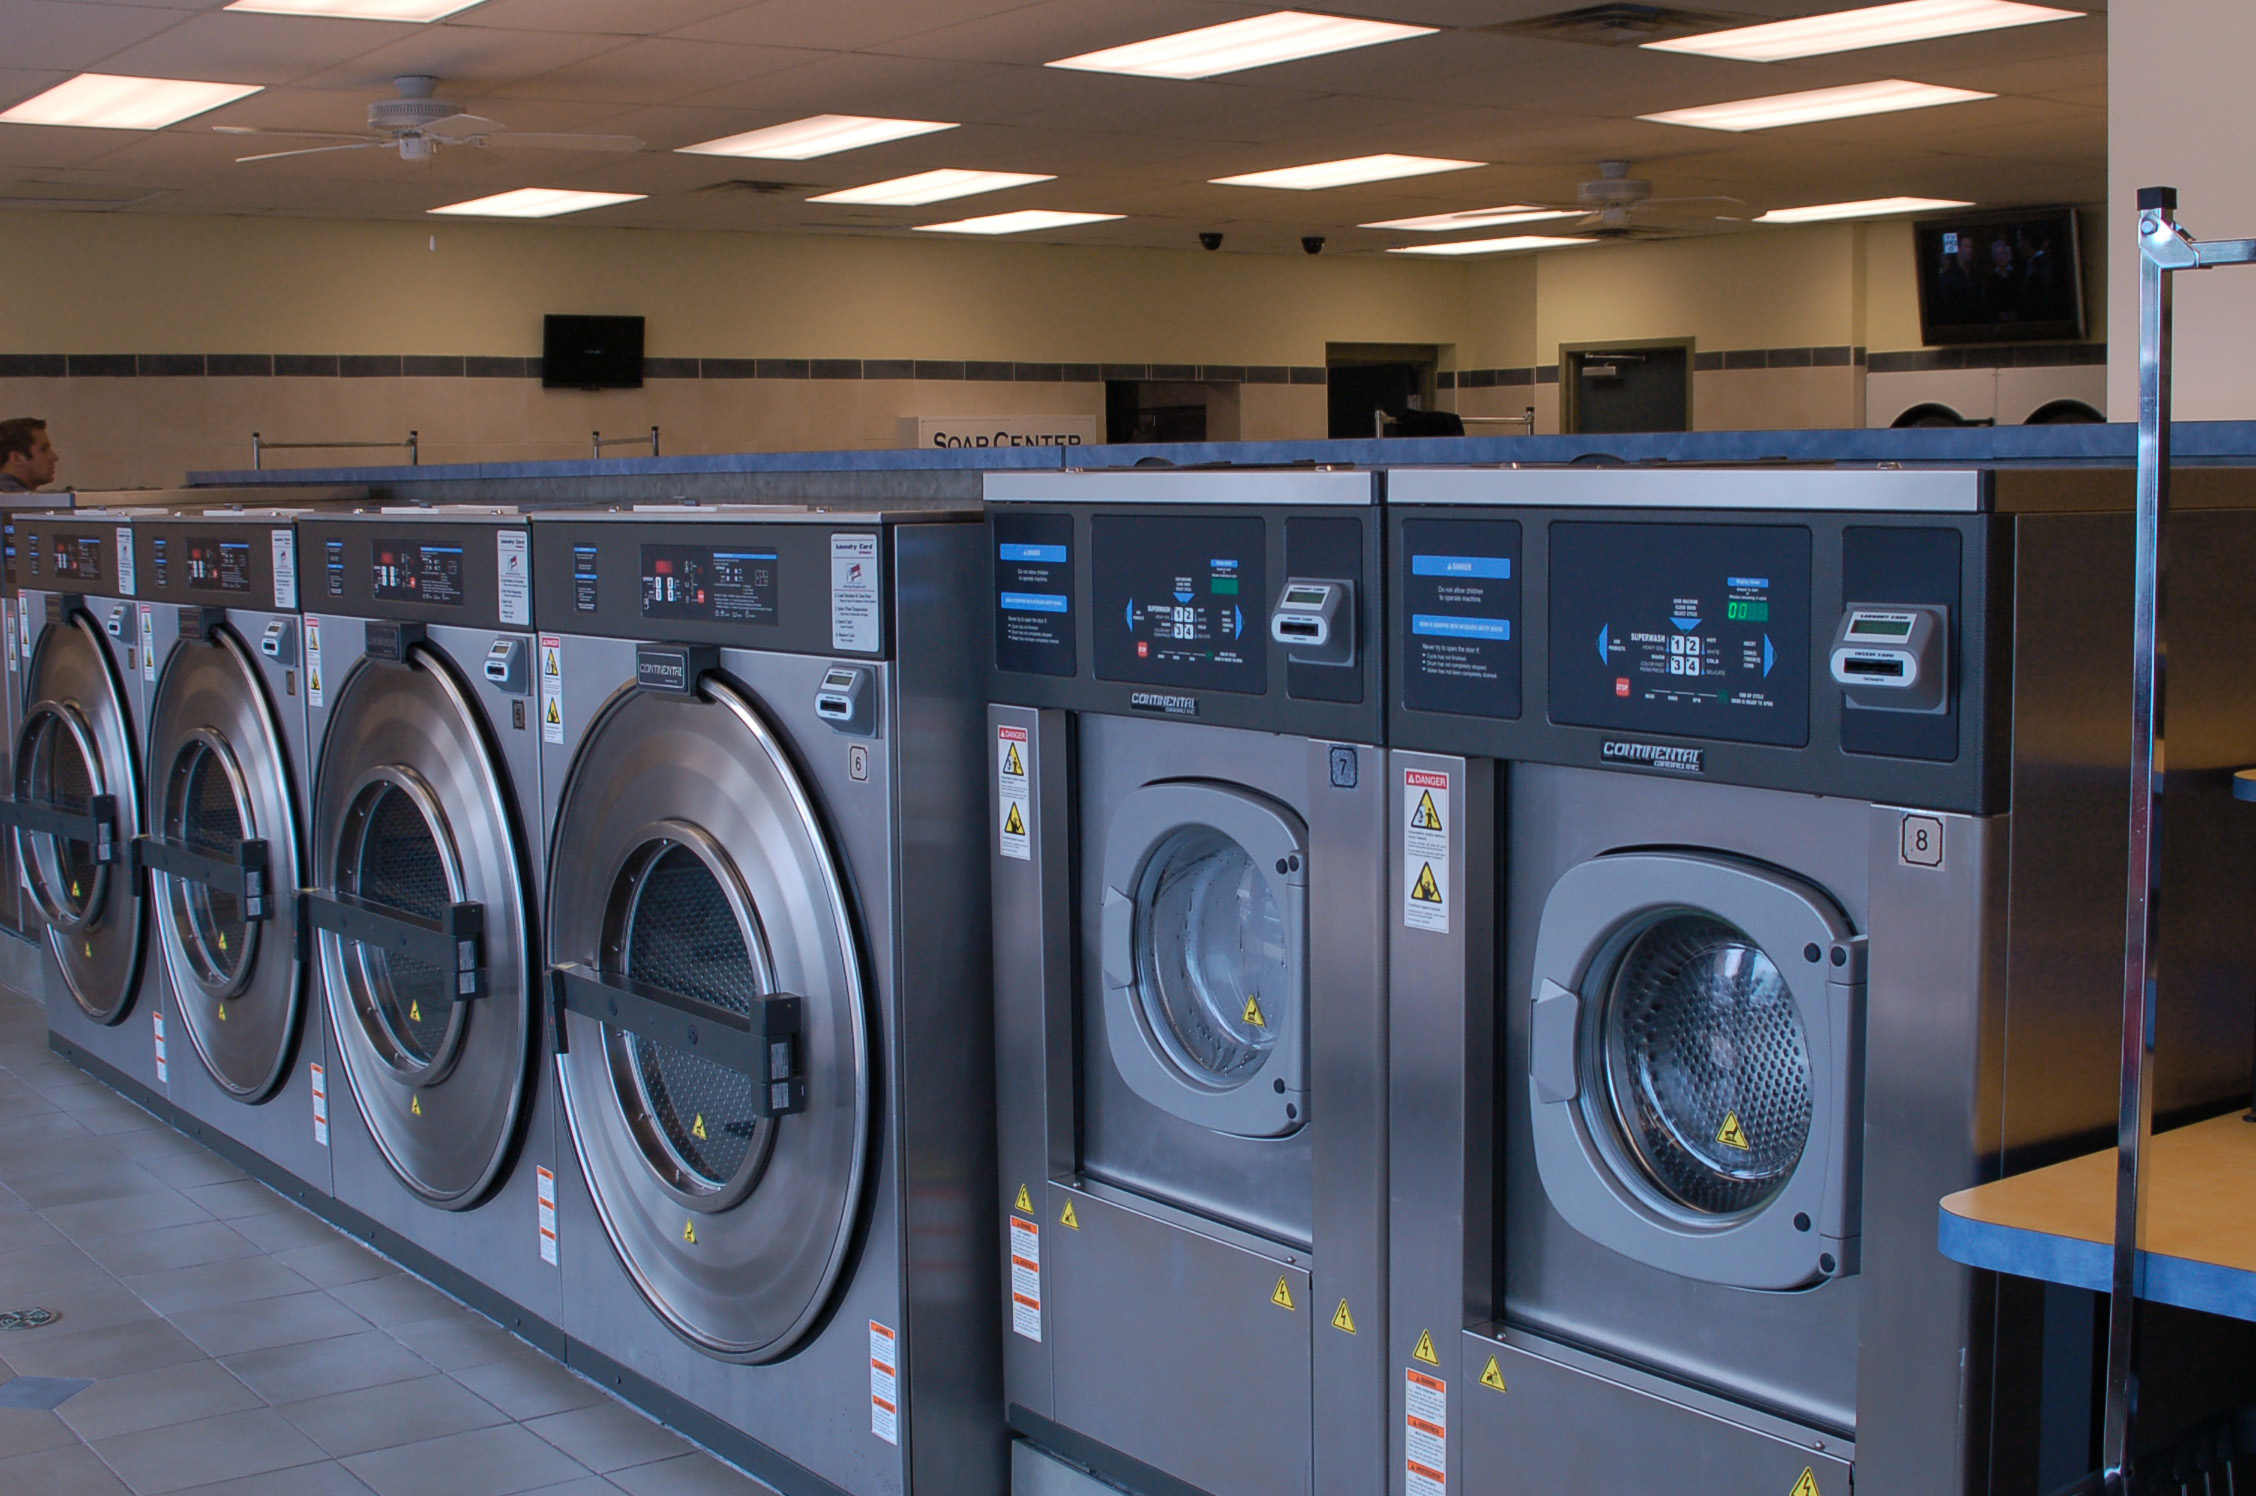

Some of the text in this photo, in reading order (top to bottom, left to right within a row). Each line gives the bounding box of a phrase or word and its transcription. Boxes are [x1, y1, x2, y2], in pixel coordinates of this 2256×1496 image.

[1631, 633, 1665, 643] SUPERWASH
[1689, 640, 1696, 651] 2
[1674, 659, 1681, 671] 3
[1688, 661, 1696, 672] 4
[1131, 693, 1198, 708] CONTINENTAL
[1005, 730, 1026, 740] DANGER
[1603, 742, 1703, 763] CONTINENTAL
[856, 756, 861, 771] 6
[1339, 758, 1347, 776] 7
[1415, 774, 1446, 787] DANGER
[1916, 829, 1928, 851] 8
